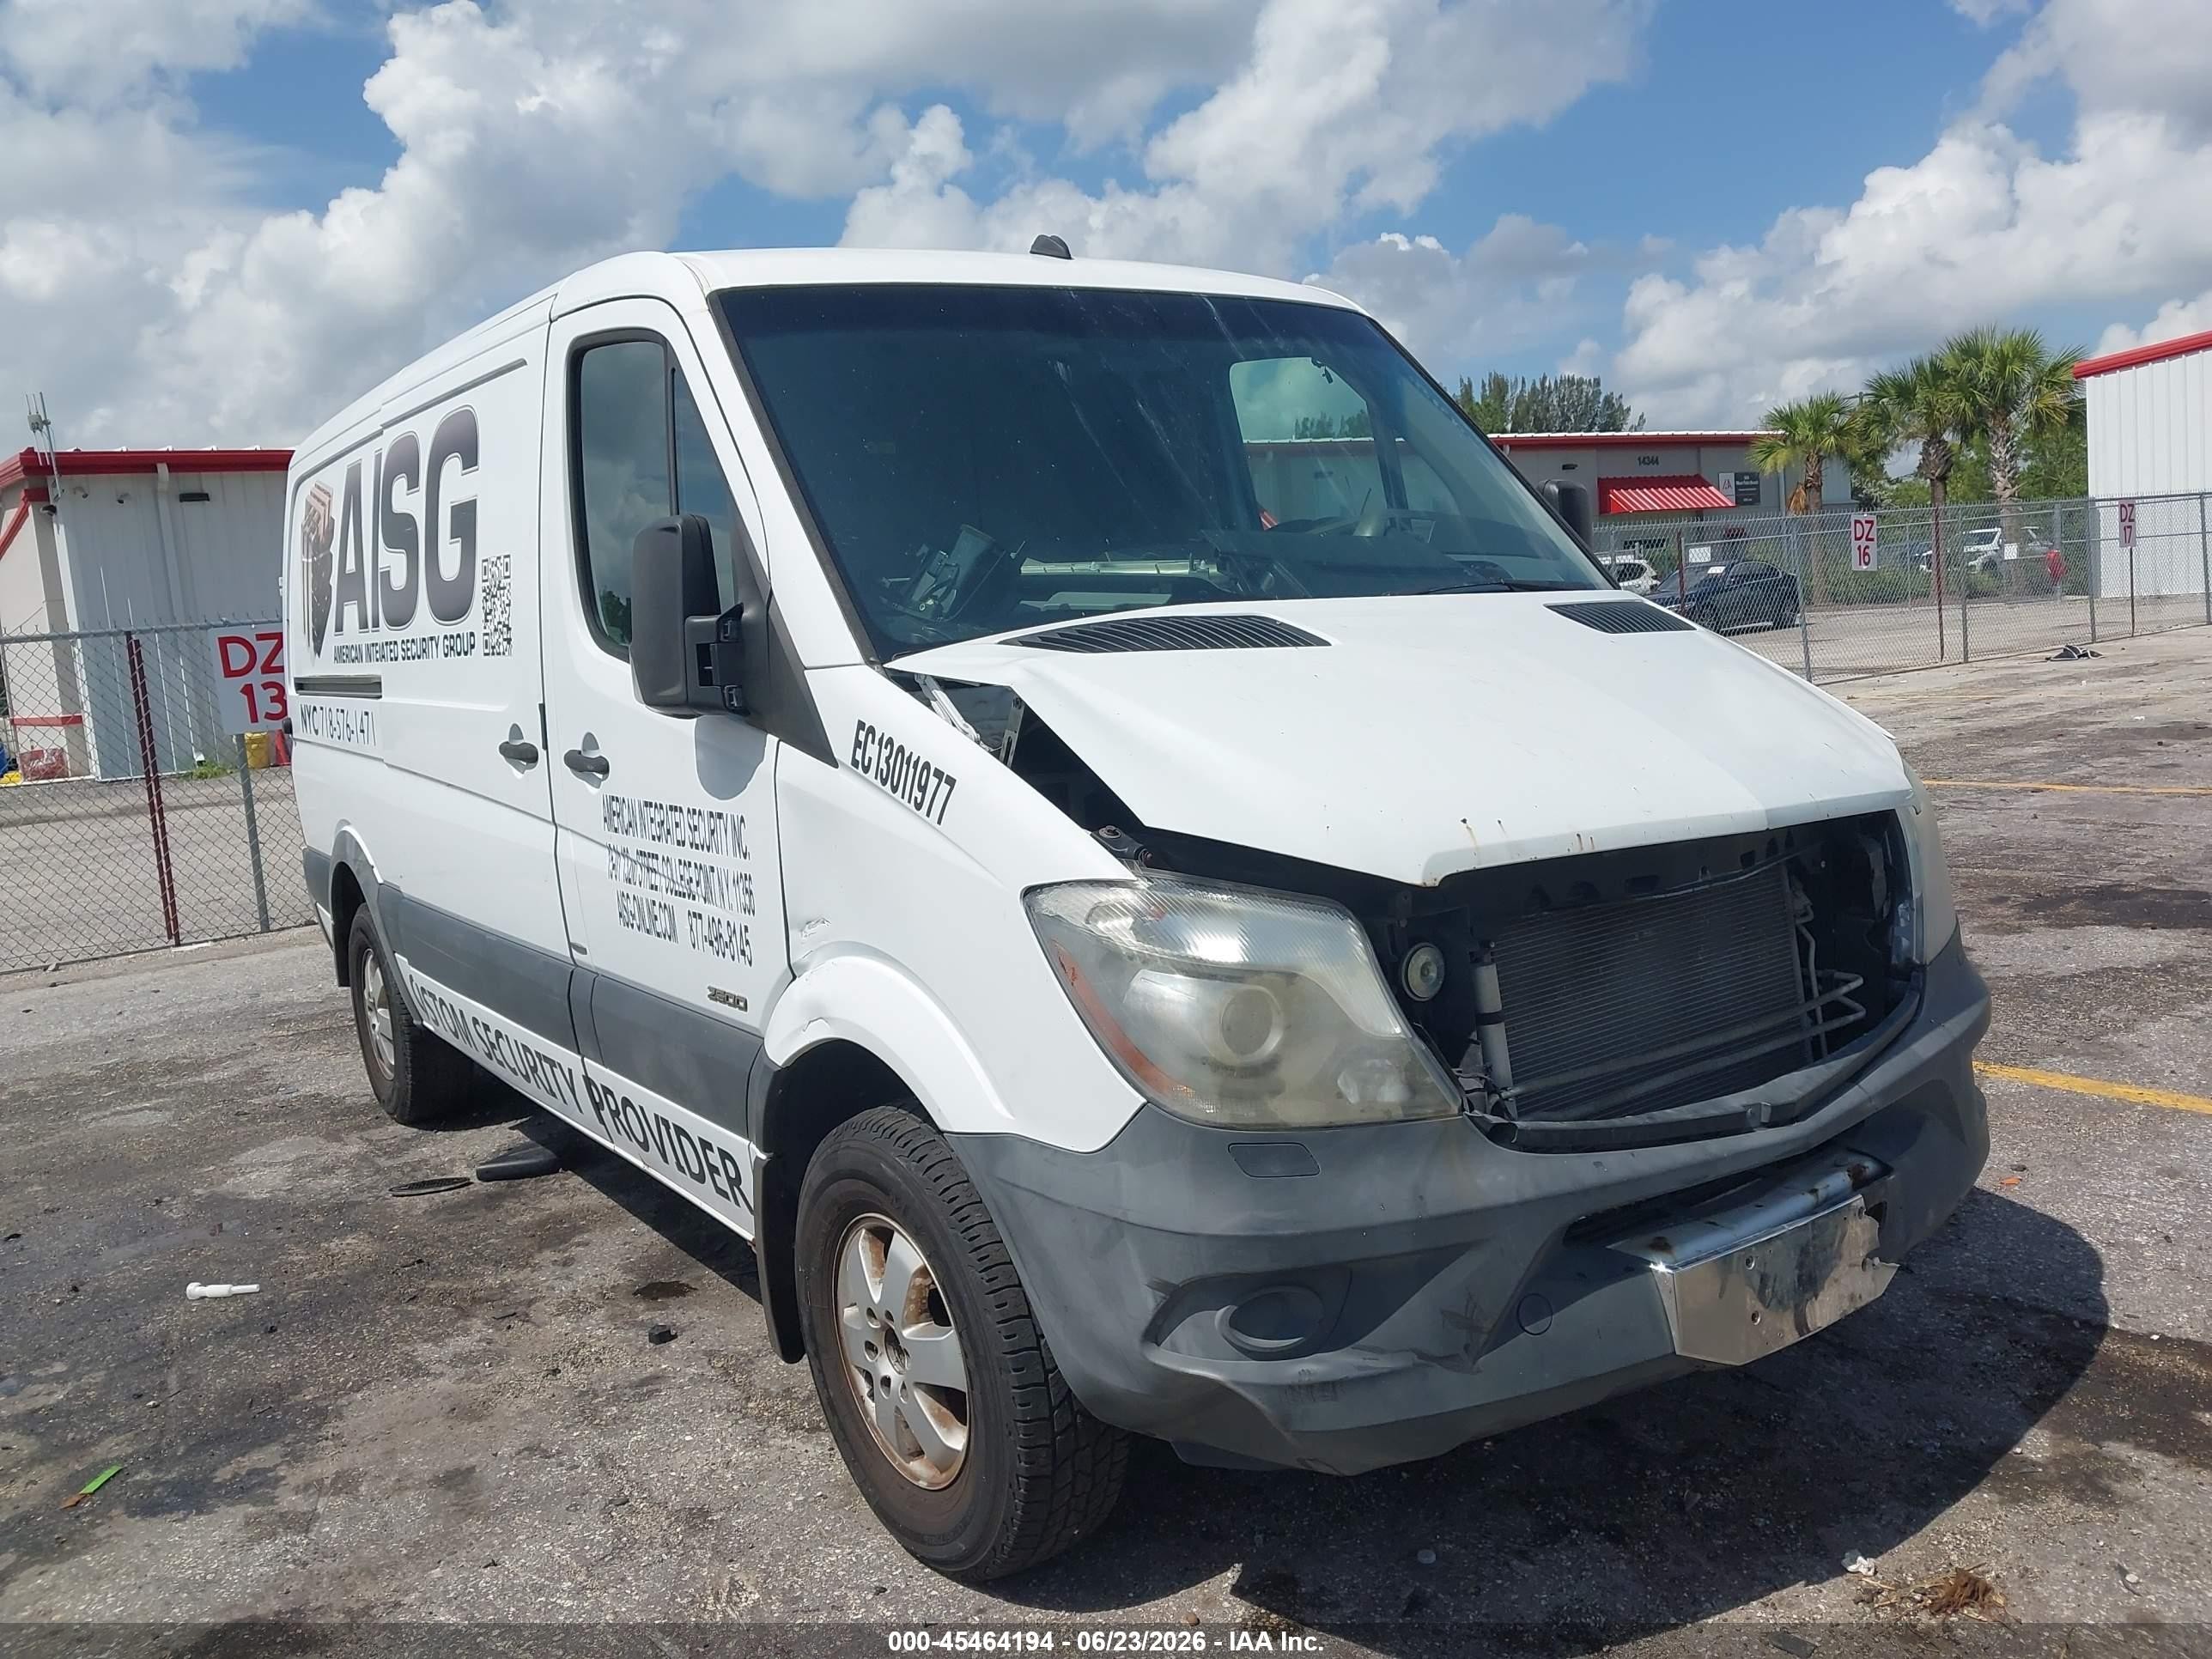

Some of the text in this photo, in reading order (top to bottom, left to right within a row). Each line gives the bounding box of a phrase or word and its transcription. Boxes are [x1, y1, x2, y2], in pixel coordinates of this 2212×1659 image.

[334, 404, 480, 636] AISG
[1854, 520, 1875, 541] DZ
[2120, 503, 2135, 522] DZ
[1857, 544, 1870, 566] 16
[2124, 526, 2132, 544] 17
[217, 632, 284, 678] DZ
[333, 644, 364, 664] AMERICAN
[400, 635, 440, 661] SECURITY
[442, 631, 476, 659] GROUP
[240, 681, 288, 723] 13
[301, 704, 319, 736] NYC
[851, 719, 957, 825] EC13011977
[603, 793, 638, 838] AMERICAN
[638, 799, 686, 848] INTEGRATED
[687, 807, 729, 857] SECURITY
[662, 854, 696, 901] COLLEGE
[694, 861, 718, 907] POINT
[732, 870, 756, 917] 11356
[687, 909, 752, 968] 877-496-8145
[471, 1017, 584, 1114] SECURITY
[582, 1074, 754, 1216] PROVIDER
